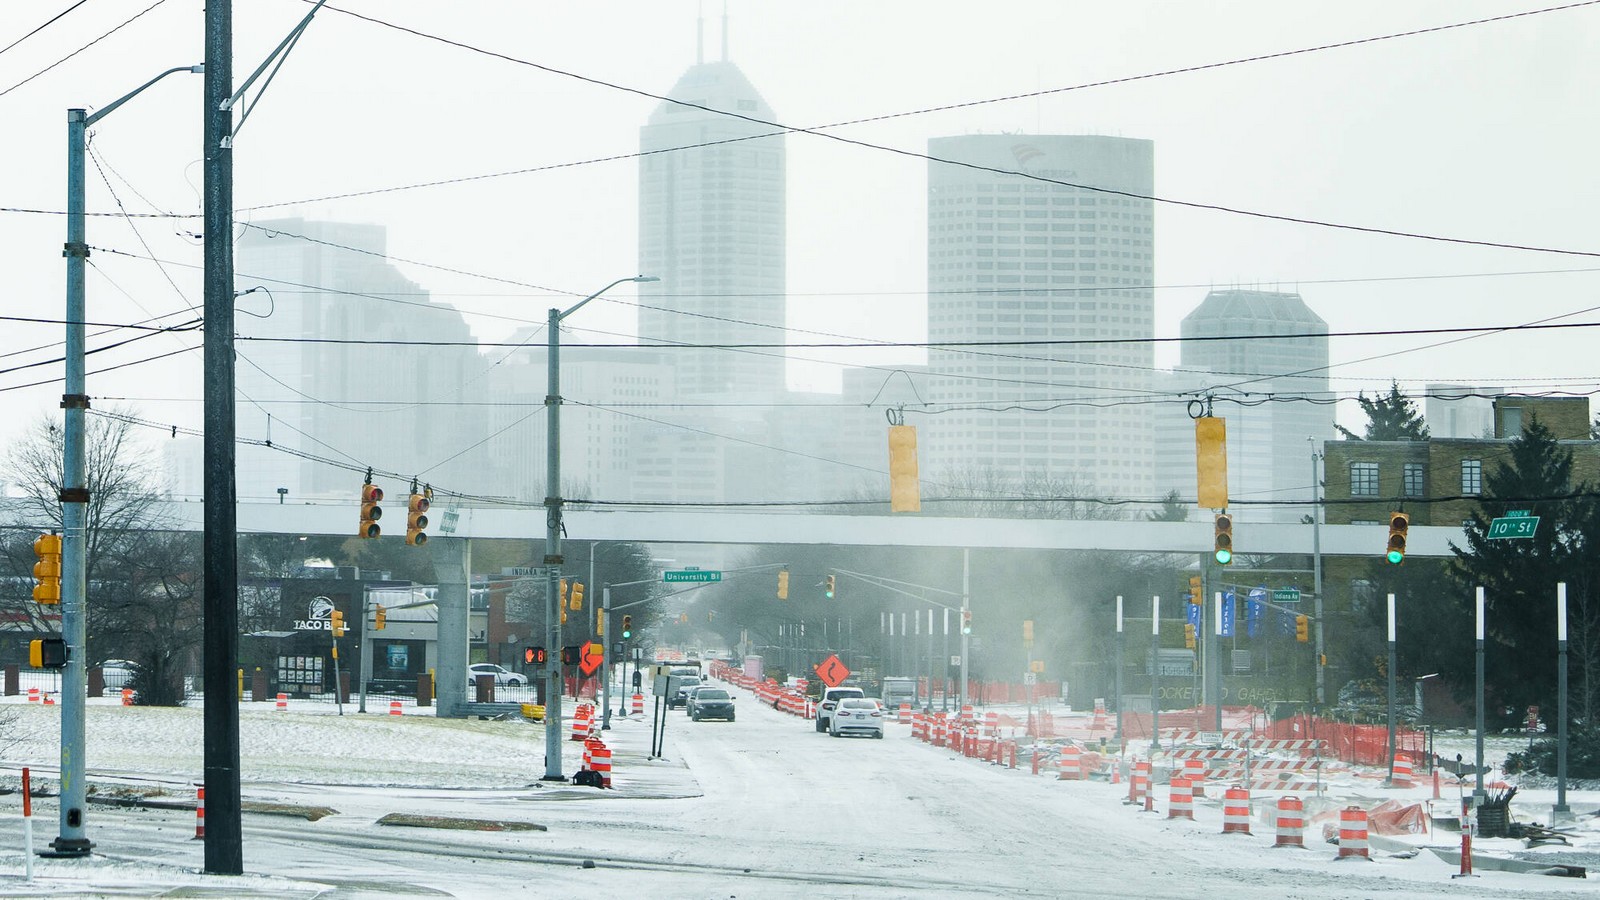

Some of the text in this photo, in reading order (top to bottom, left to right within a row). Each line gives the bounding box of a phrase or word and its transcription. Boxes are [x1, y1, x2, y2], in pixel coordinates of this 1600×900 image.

[1518, 522, 1531, 532] St
[511, 567, 537, 576] INDIANA
[1274, 592, 1291, 600] Indiana
[293, 620, 350, 631] TACO BL
[537, 649, 544, 662] 8
